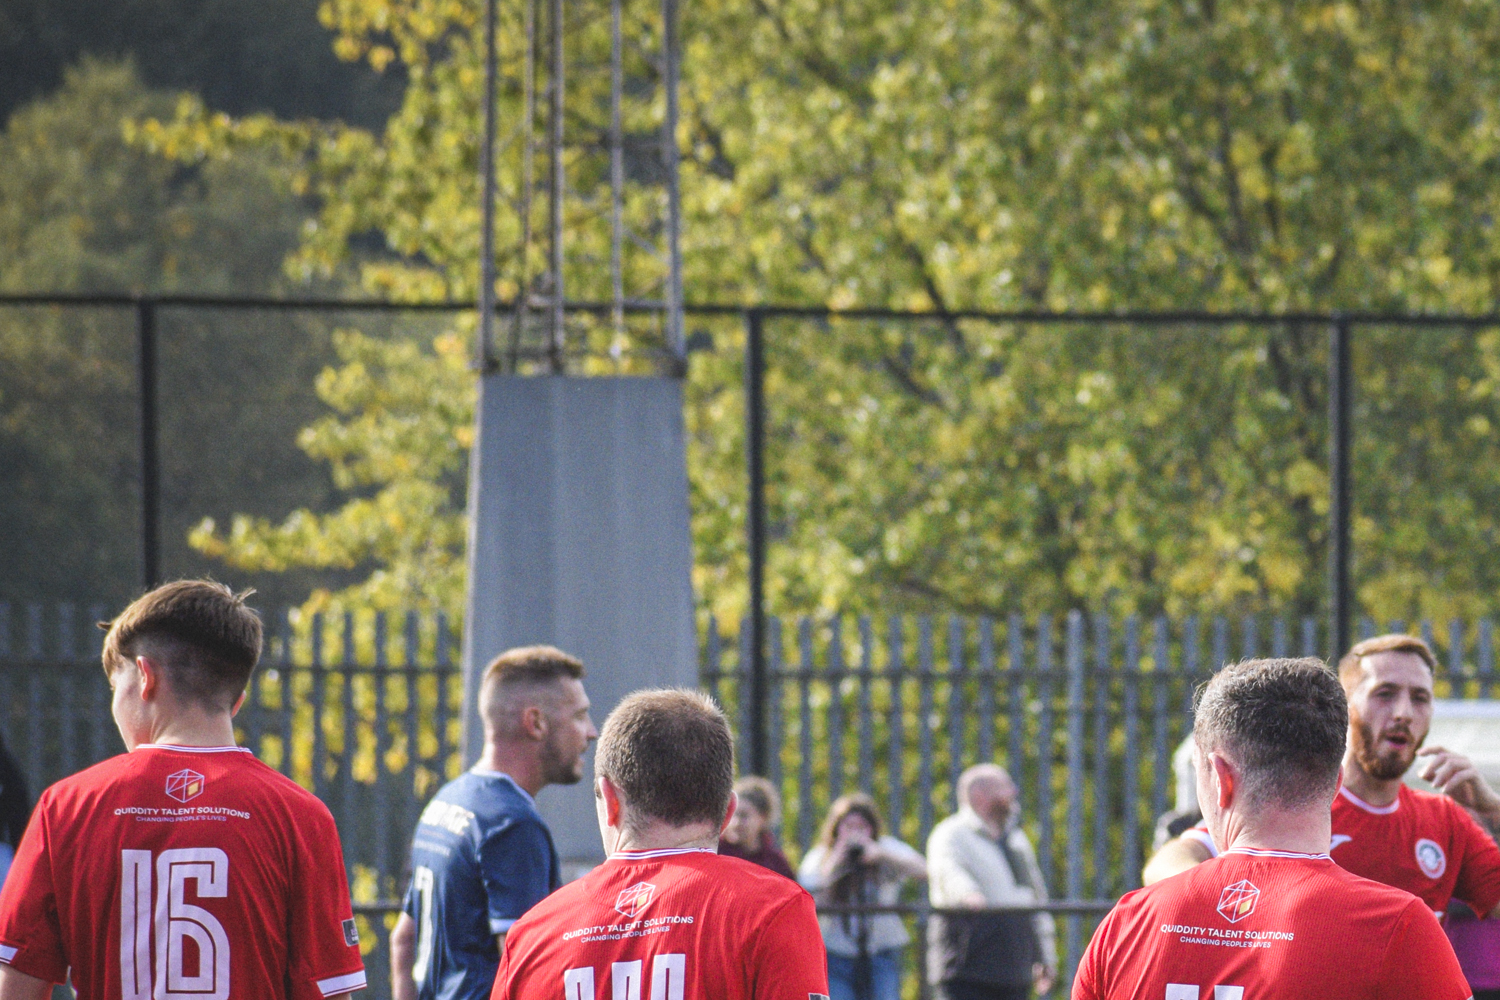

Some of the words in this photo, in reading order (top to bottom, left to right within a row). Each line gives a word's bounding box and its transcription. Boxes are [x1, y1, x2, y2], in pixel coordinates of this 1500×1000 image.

[114, 807, 159, 816] QUIDDITY
[161, 807, 196, 815] TALENT
[197, 806, 250, 819] SOLUTIONS
[563, 926, 605, 940] QUIDDITY
[607, 921, 642, 932] TALENT
[644, 916, 694, 927] SOLUTIONS
[1160, 924, 1206, 935] QUIDDITY
[1208, 928, 1243, 938] TALENT
[1244, 931, 1294, 941] SOLUTIONS
[1180, 936, 1220, 946] CHANGING
